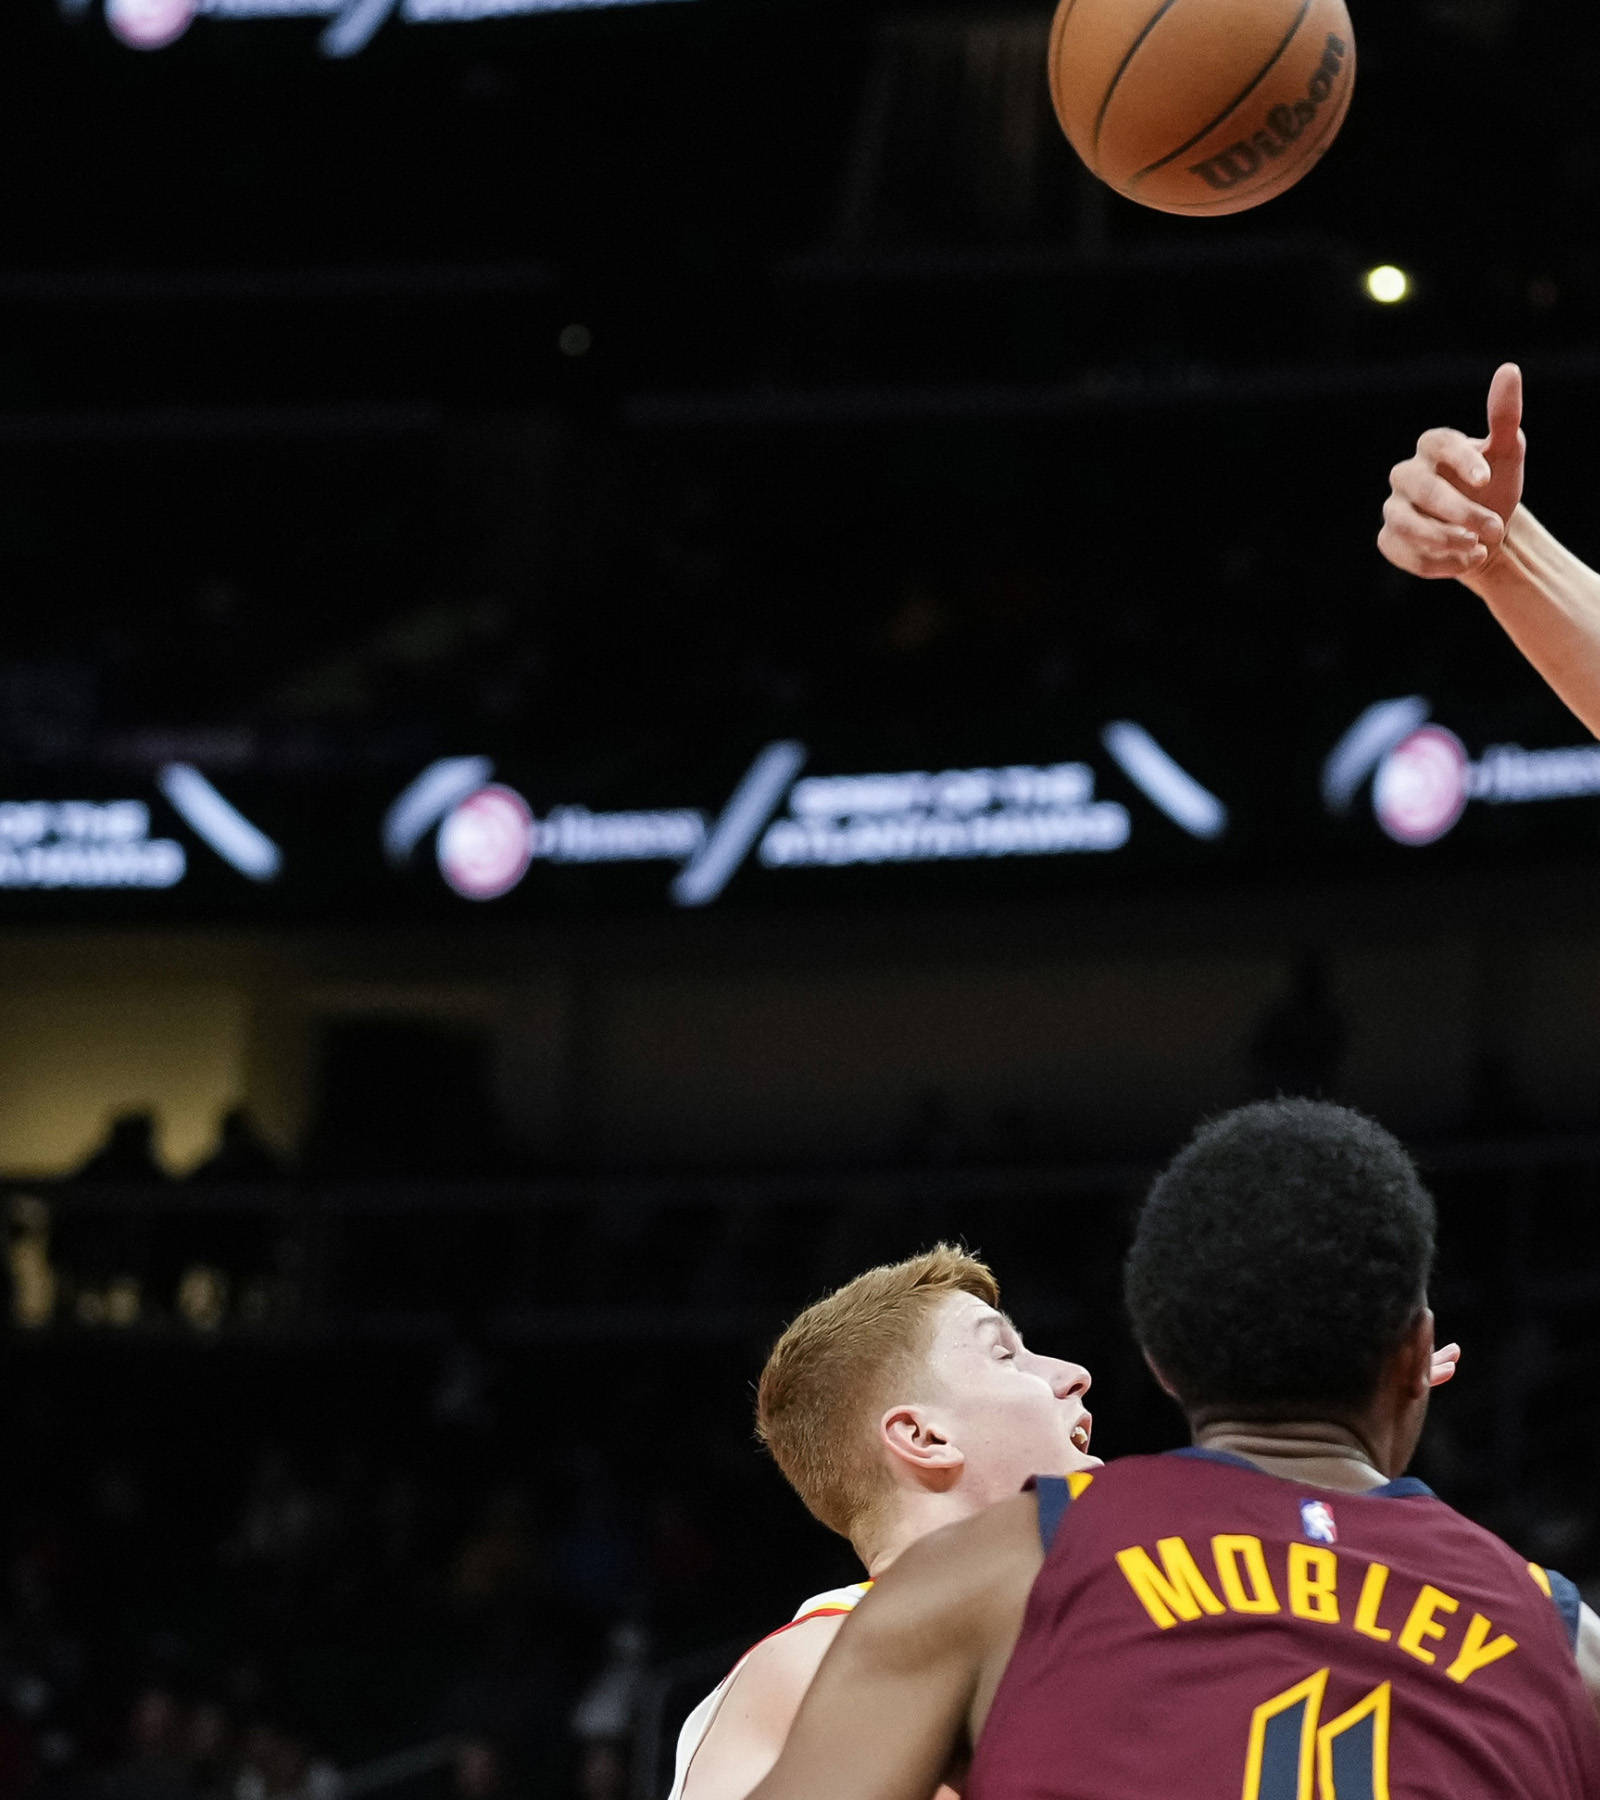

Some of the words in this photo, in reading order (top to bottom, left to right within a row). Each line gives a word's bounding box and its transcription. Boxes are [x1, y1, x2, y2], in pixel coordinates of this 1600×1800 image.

[1188, 31, 1345, 190] Wilson
[1116, 1534, 1518, 1683] MOBLEY
[1242, 1668, 1391, 1800] 11
